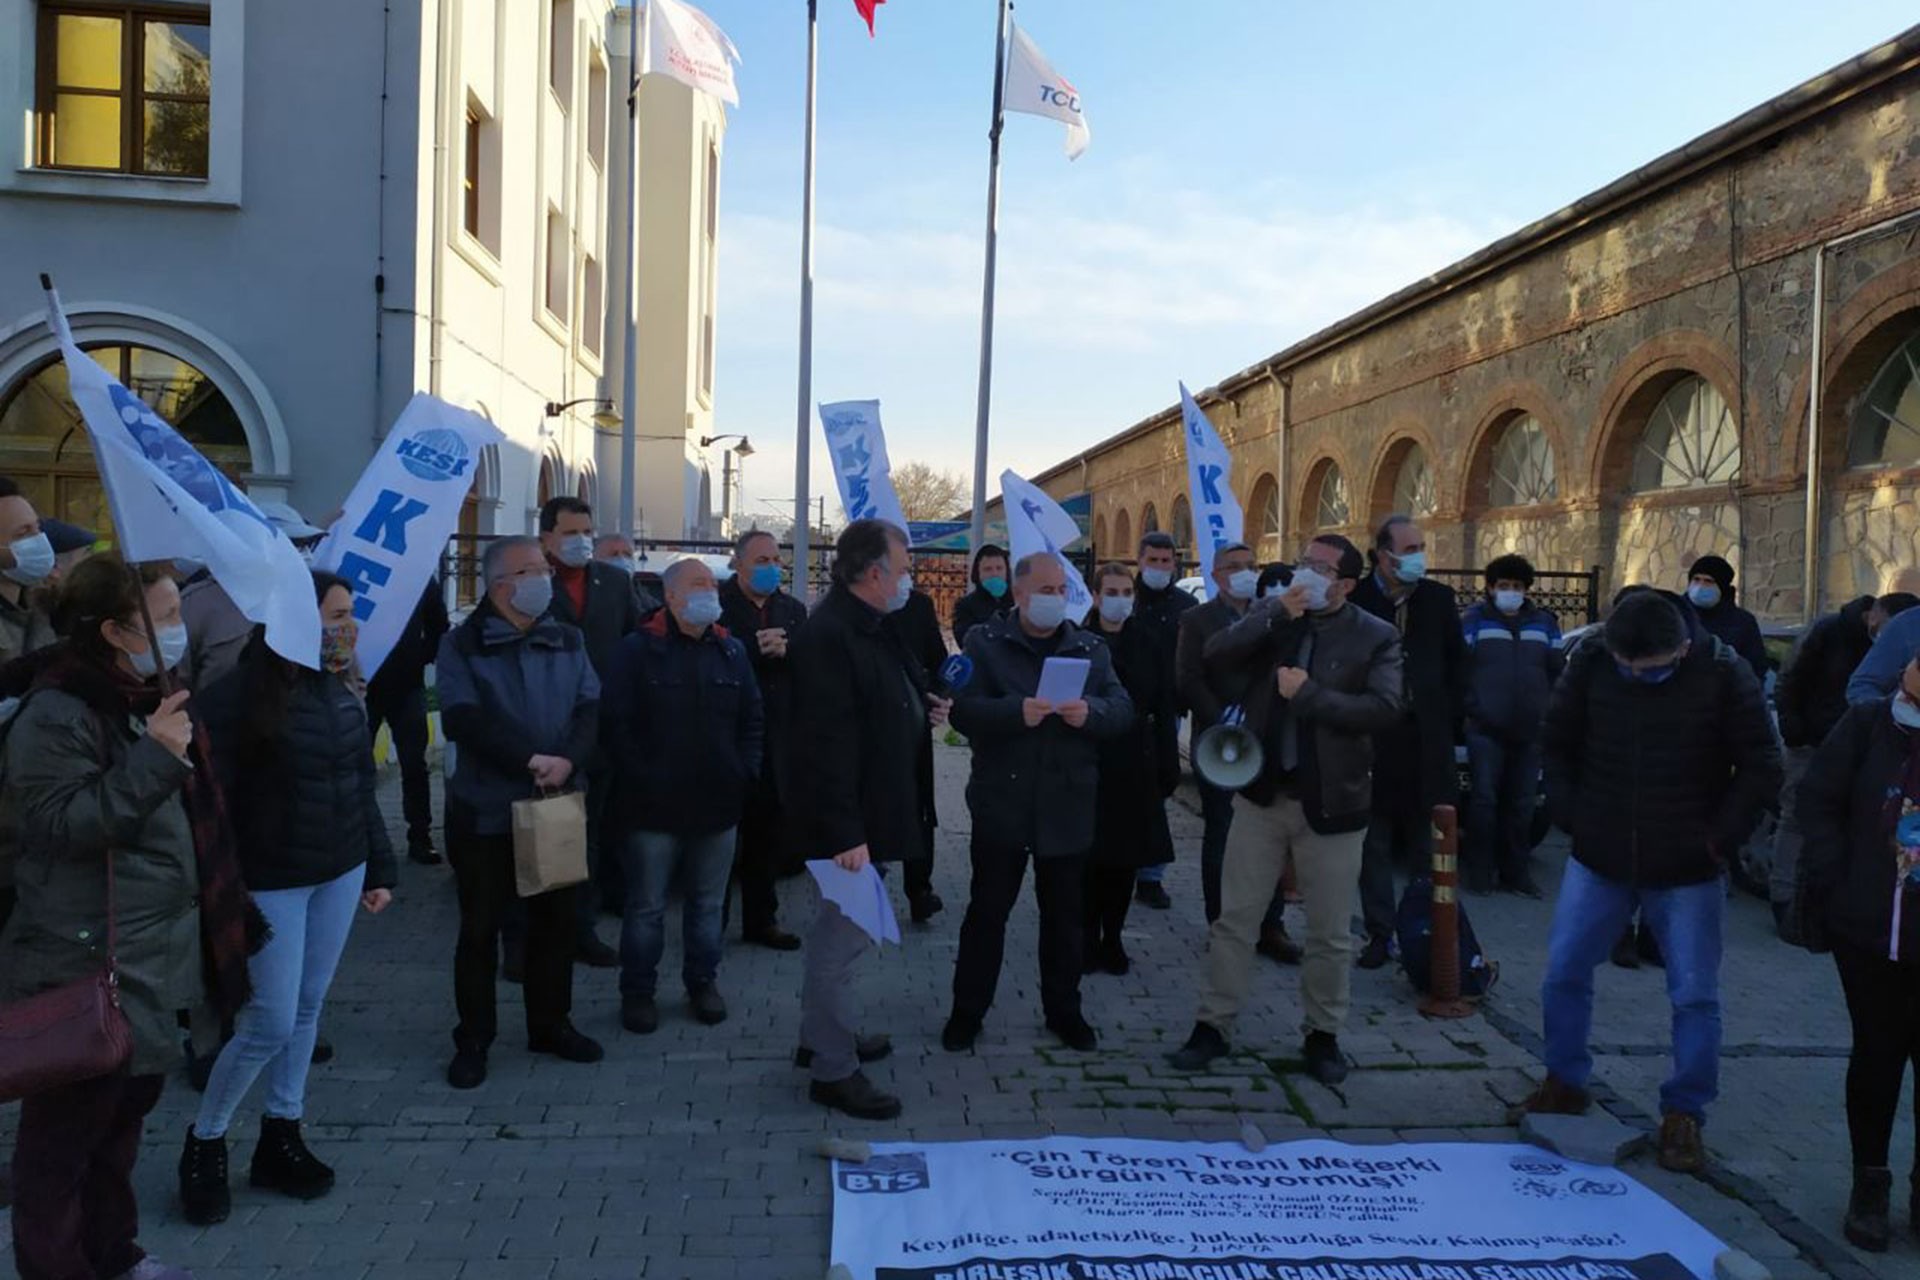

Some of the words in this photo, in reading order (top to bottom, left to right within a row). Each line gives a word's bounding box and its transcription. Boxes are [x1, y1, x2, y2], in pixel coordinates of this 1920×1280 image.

[396, 437, 470, 477] KESK
[1031, 1164, 1167, 1182] Sürgün
[1081, 1150, 1188, 1168] Tören
[1197, 1154, 1290, 1171] Treni
[1298, 1156, 1443, 1174] Meğerki
[846, 1172, 917, 1192] BTS
